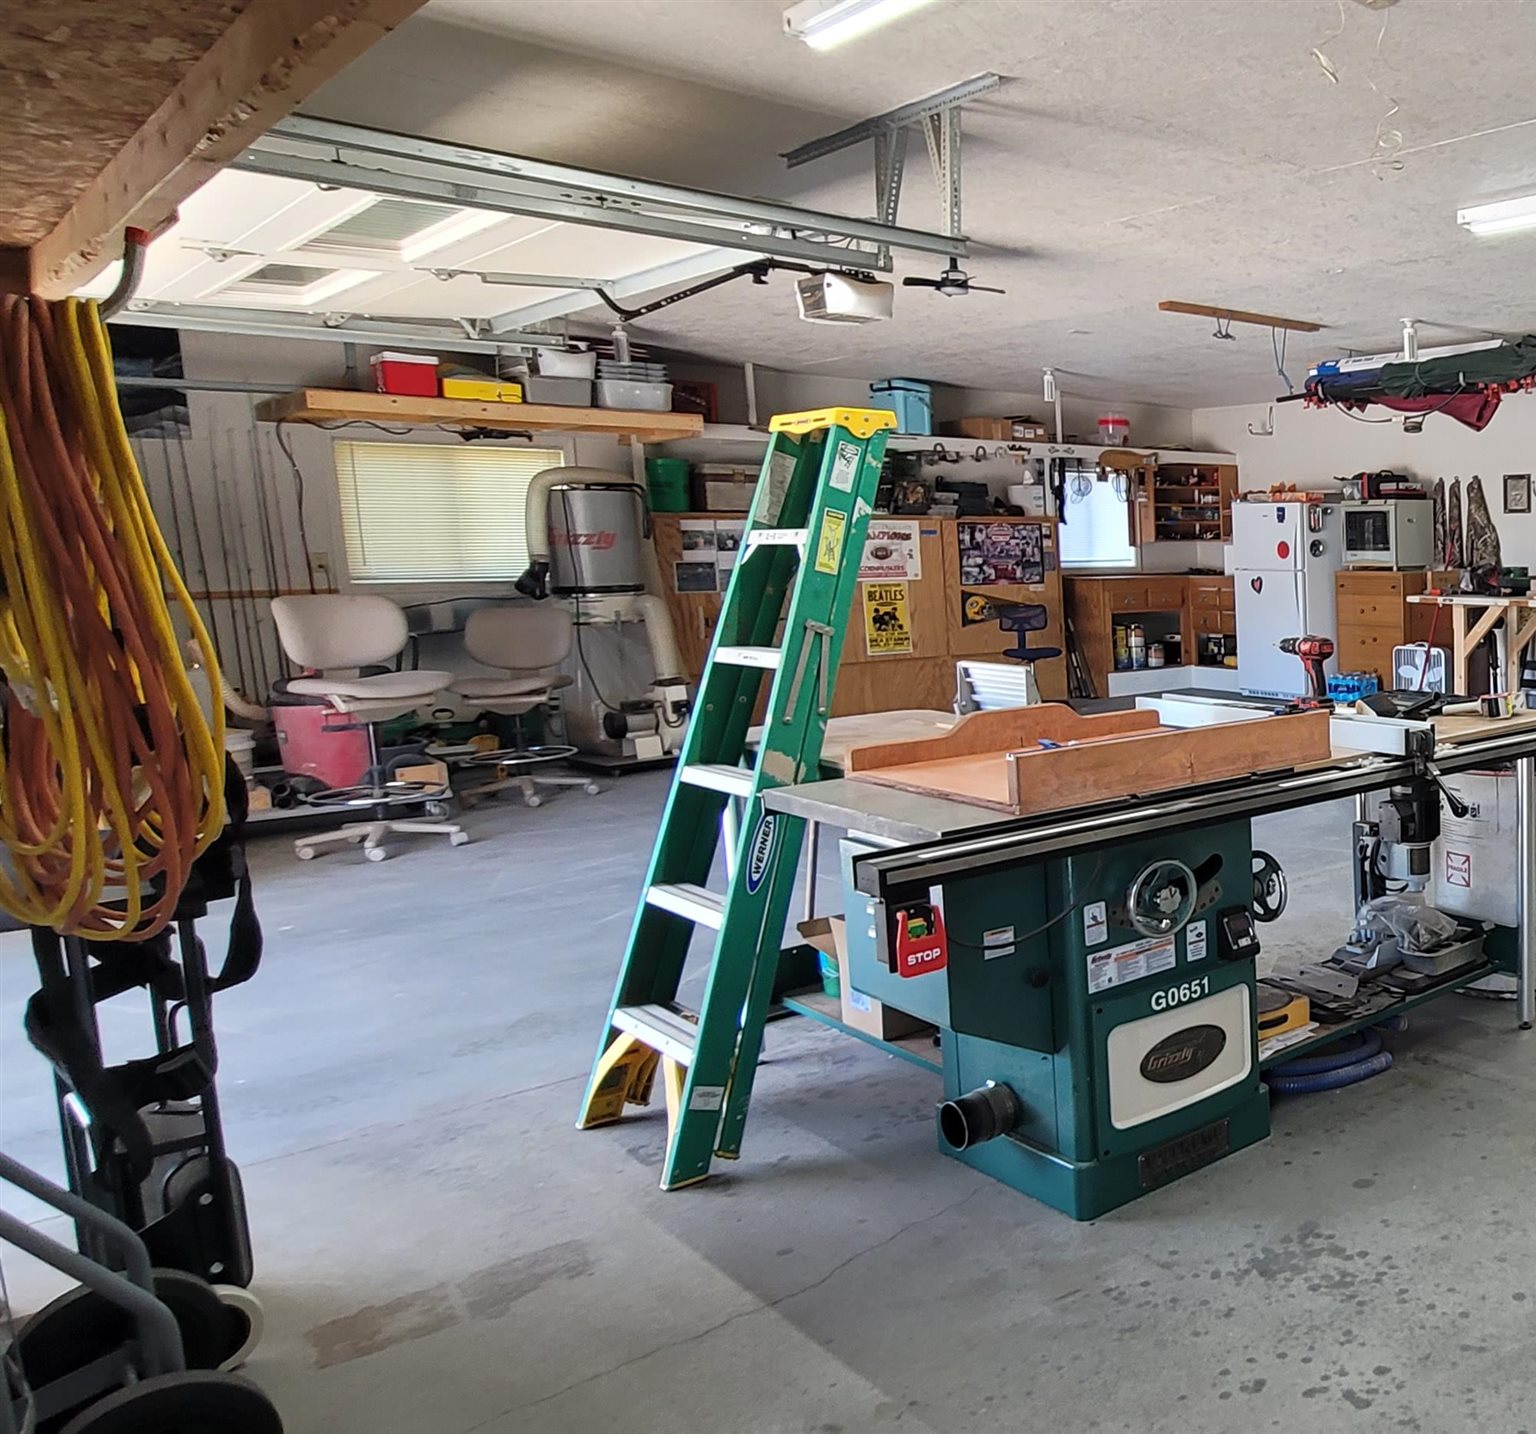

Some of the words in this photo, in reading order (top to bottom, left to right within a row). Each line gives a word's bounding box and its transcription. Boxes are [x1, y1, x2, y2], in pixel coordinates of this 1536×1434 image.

[867, 589, 905, 602] BEATLES
[752, 820, 773, 874] WERNER
[907, 947, 942, 966] STOP
[1151, 976, 1209, 1011] G0651
[1147, 1046, 1195, 1071] Grizzly
